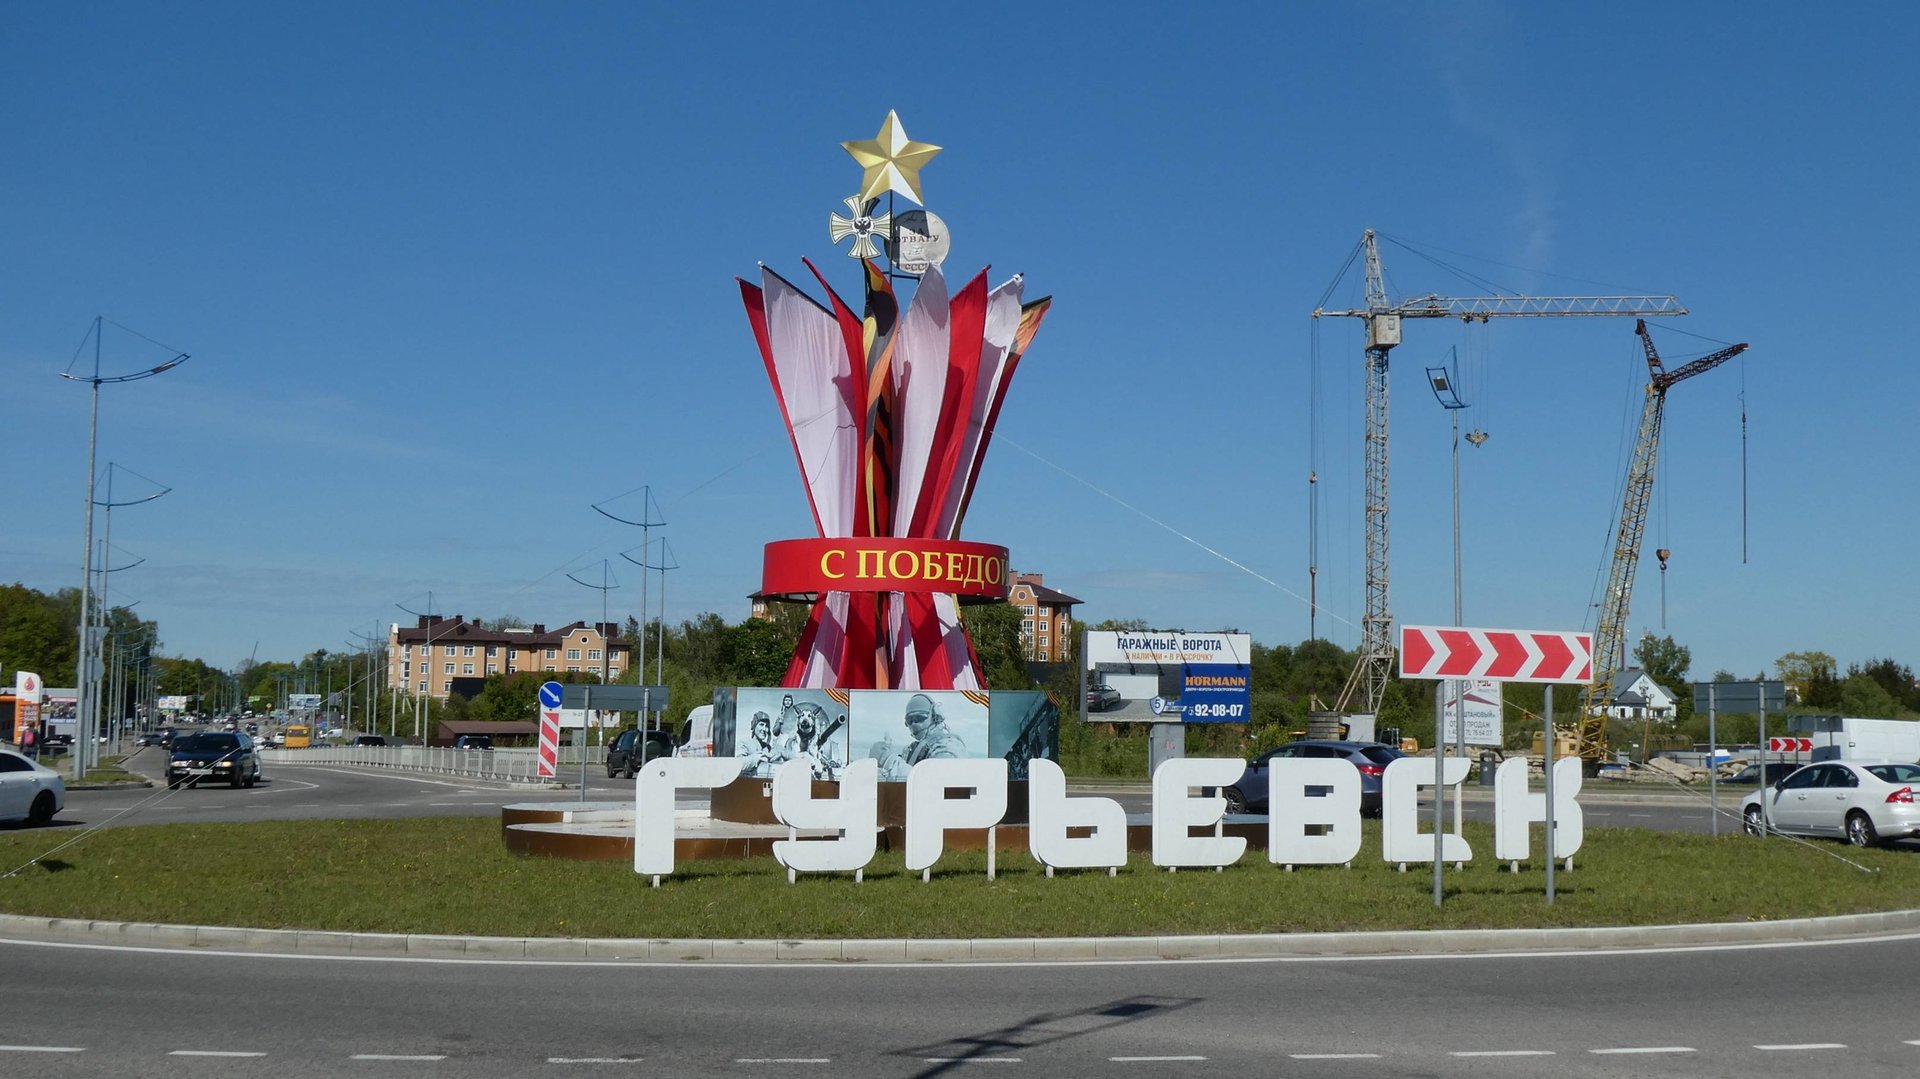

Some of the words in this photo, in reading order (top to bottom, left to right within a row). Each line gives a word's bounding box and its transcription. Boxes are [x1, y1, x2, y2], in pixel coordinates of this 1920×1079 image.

[893, 235, 940, 243] ОТВАГУ
[821, 550, 845, 579] С
[1117, 638, 1176, 650] ГАРАЖНЫЕ
[1183, 640, 1222, 650] ВОРОТА
[1154, 699, 1161, 708] 5
[1195, 704, 1243, 717] 92-08-07
[634, 757, 1584, 876] ГУРЬЕВСК
